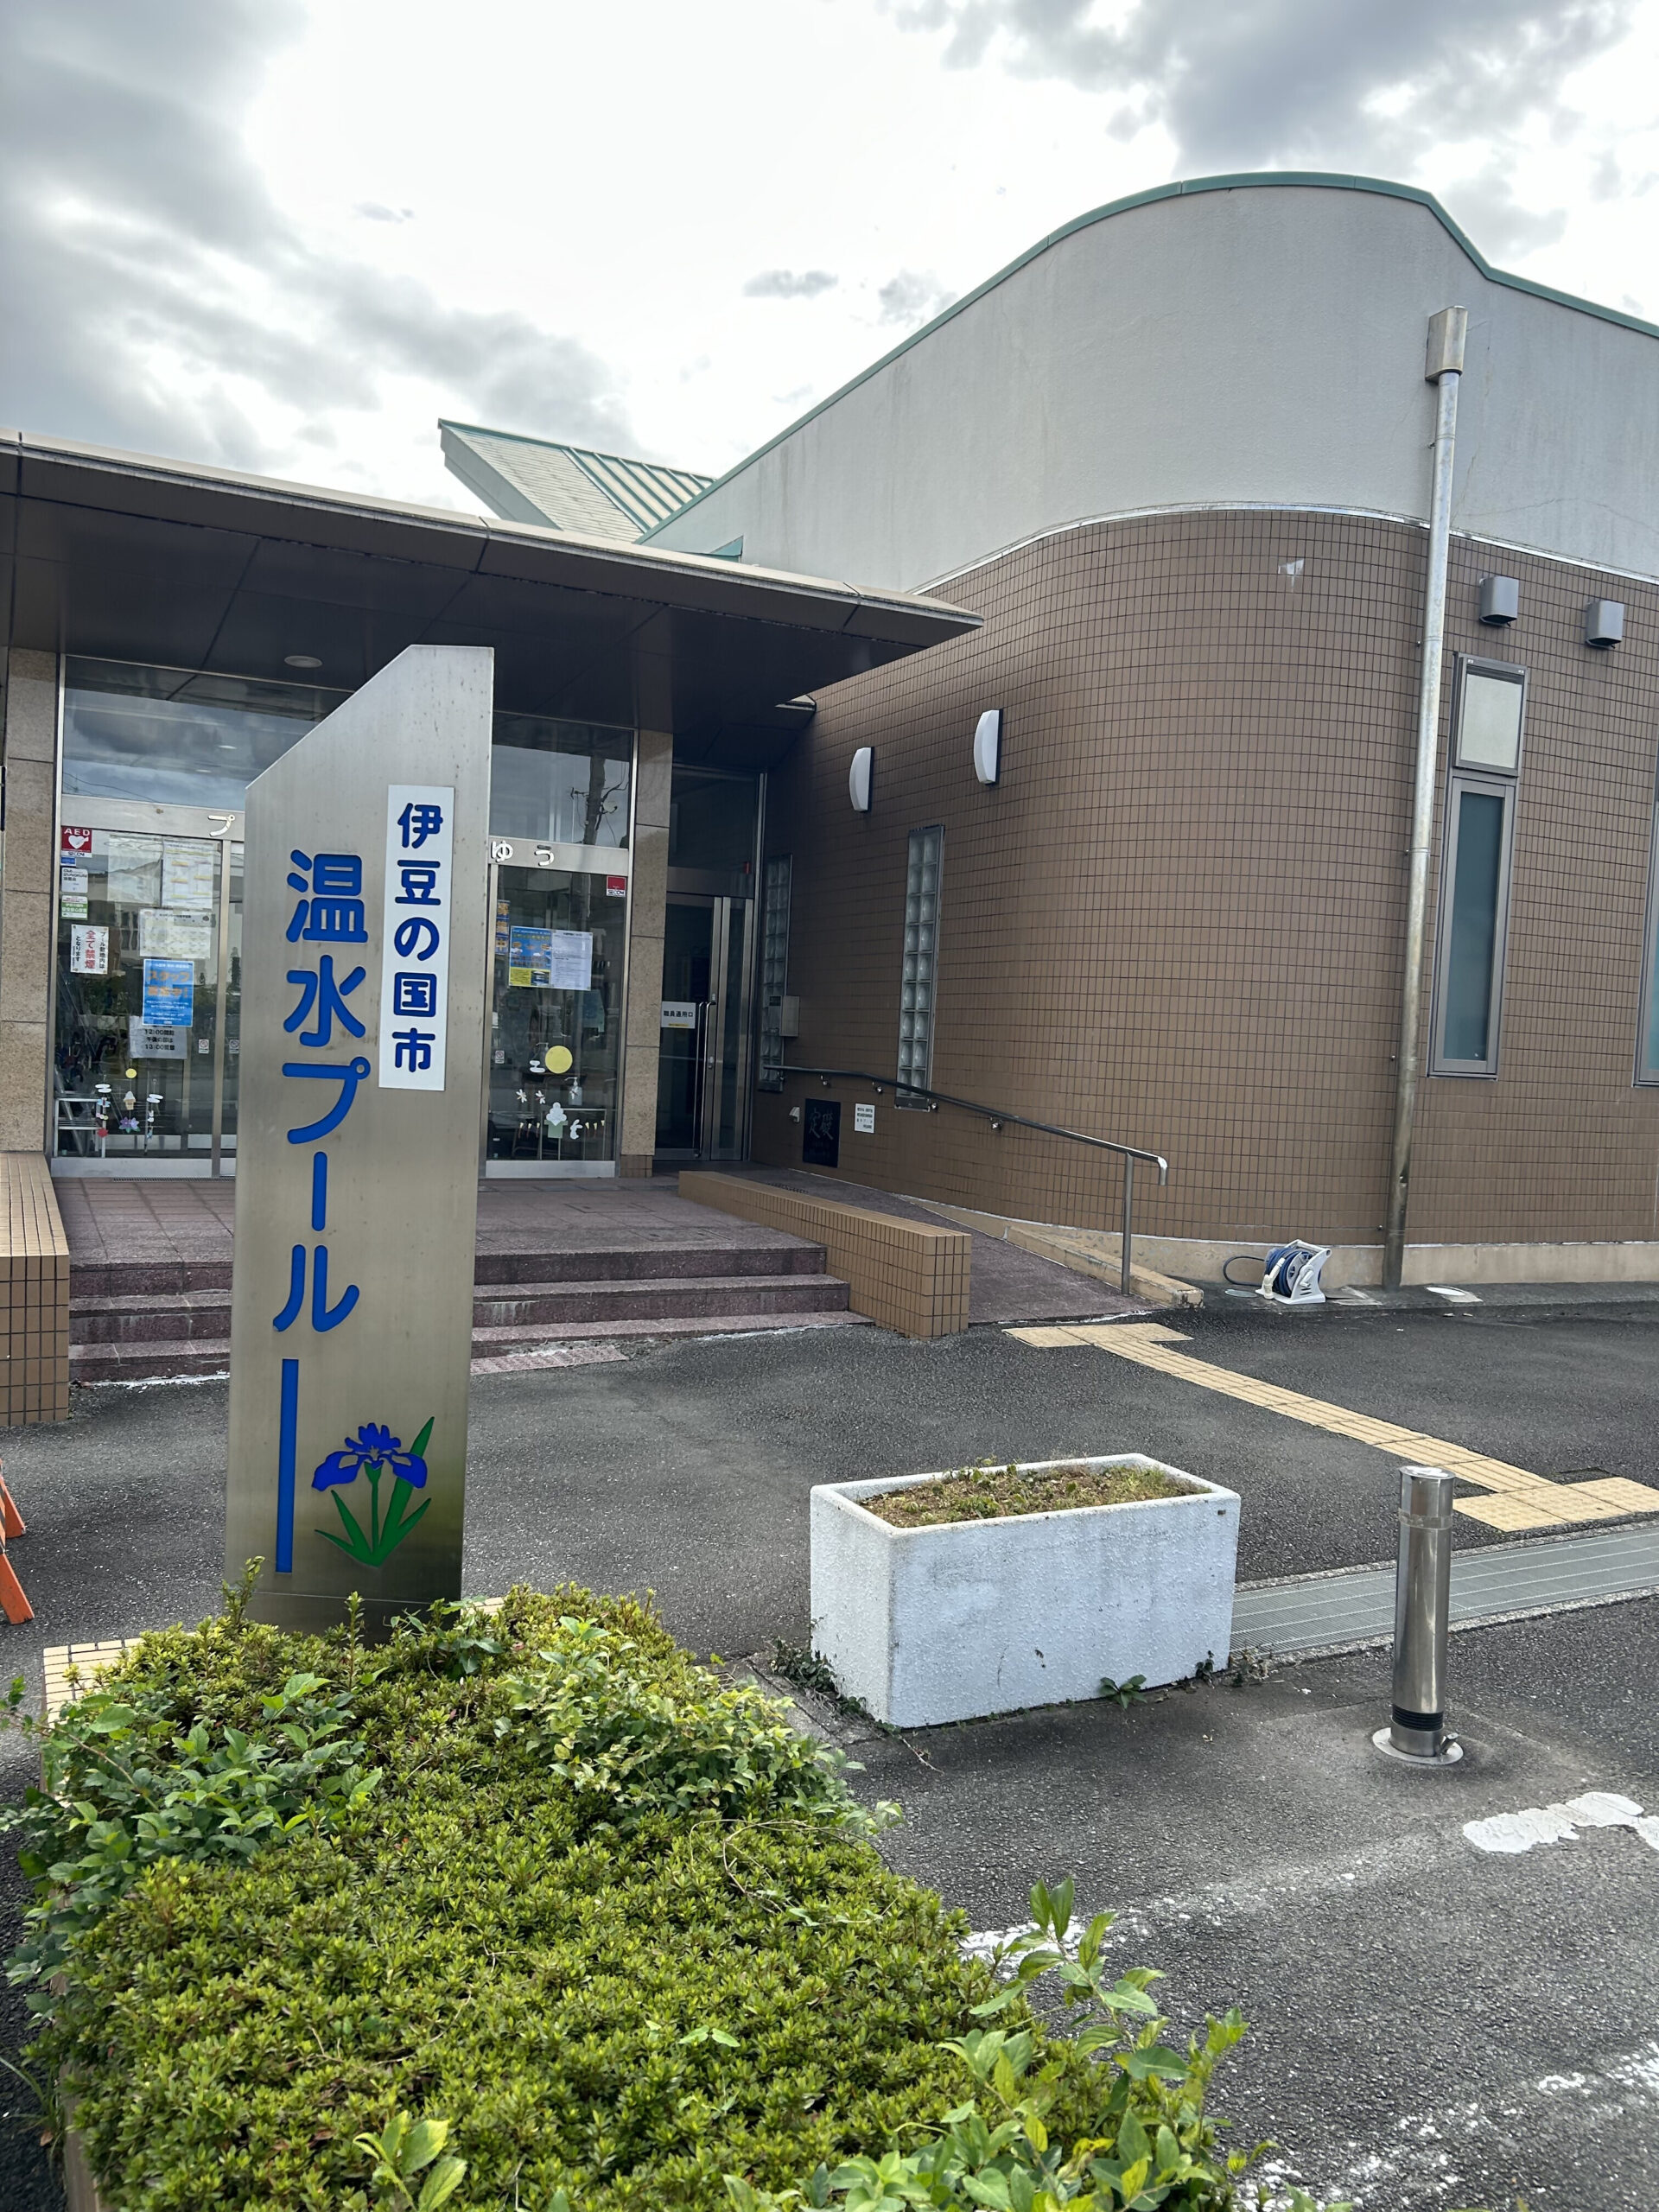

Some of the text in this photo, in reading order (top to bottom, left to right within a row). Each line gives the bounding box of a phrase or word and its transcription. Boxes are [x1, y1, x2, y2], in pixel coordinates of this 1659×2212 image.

[64, 828, 91, 836] AED
[491, 840, 555, 867] ゆう
[85, 930, 96, 969] 全て禁煙
[391, 802, 444, 1073] 伊豆の国市
[148, 970, 189, 982] スタッフ
[273, 849, 372, 1332] 温水プール
